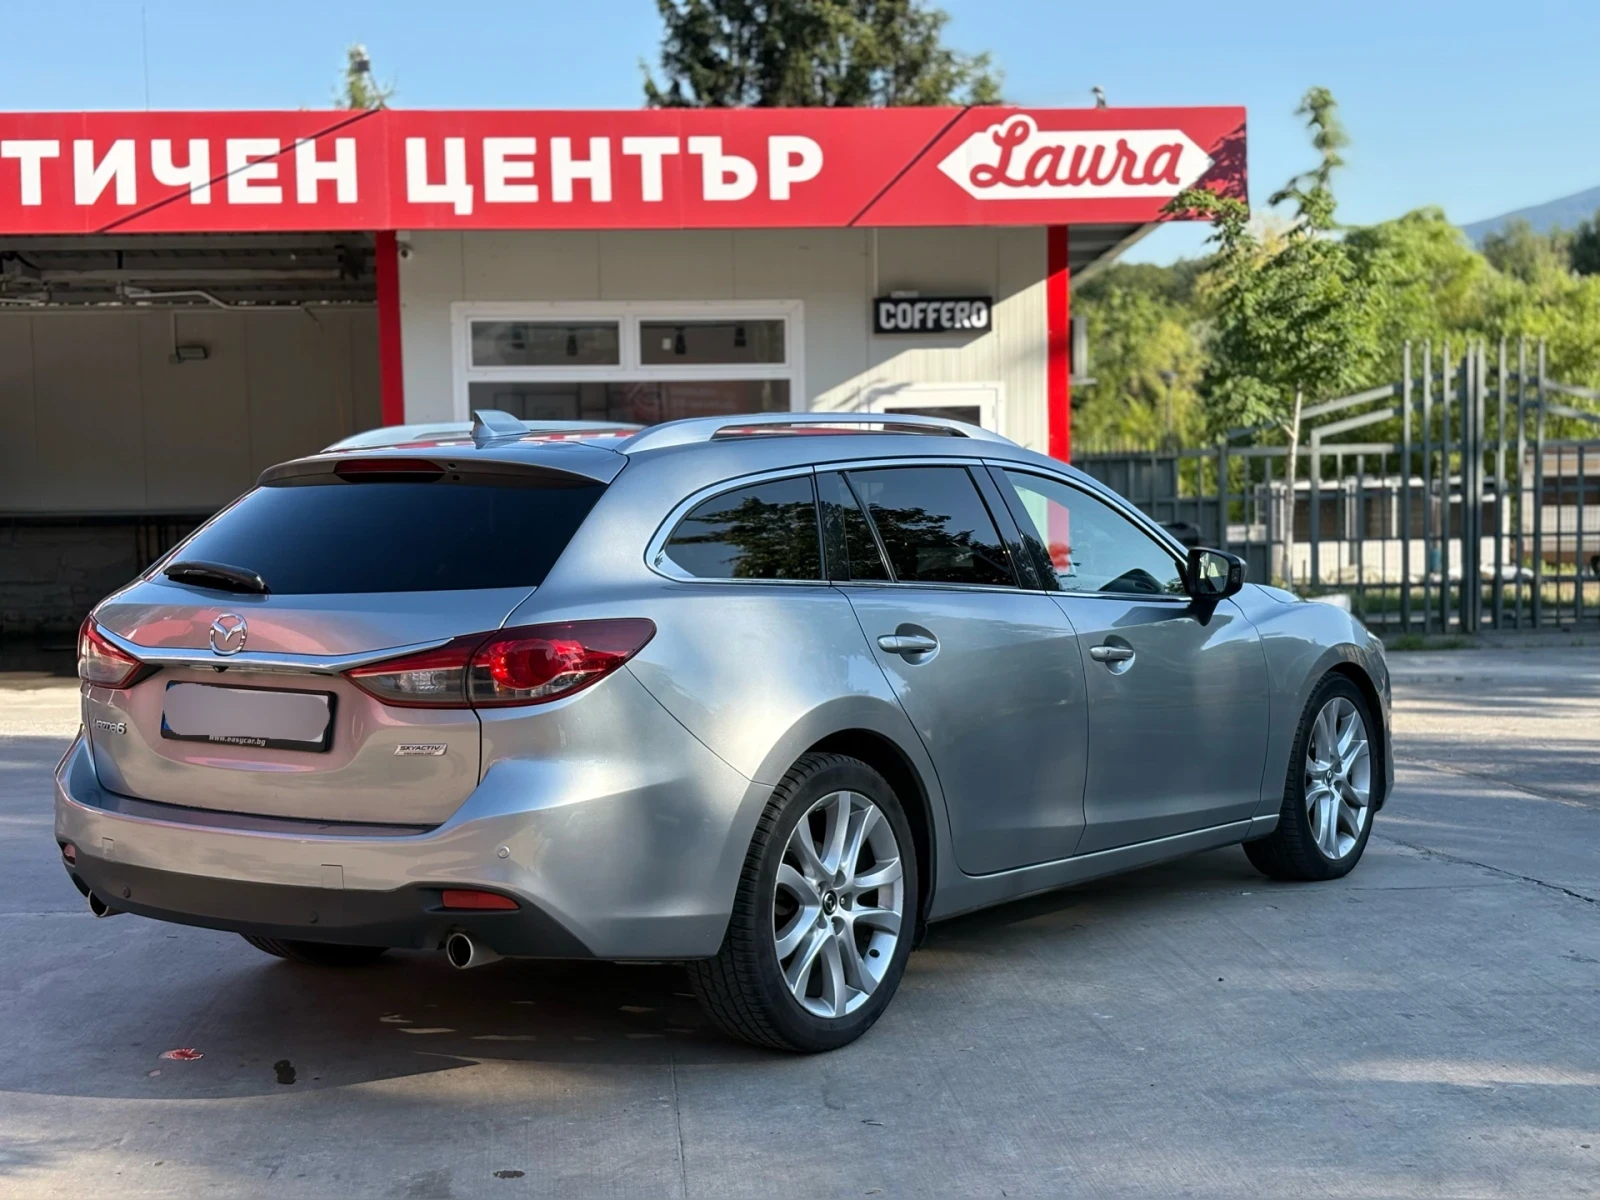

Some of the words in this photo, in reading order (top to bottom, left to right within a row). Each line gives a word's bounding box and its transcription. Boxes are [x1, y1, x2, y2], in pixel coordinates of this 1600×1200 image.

[1, 138, 358, 206] ТИЧЕН
[405, 135, 824, 215] ЦЕНТЪР
[969, 119, 1184, 188] Laura
[879, 301, 988, 330] COFFERO
